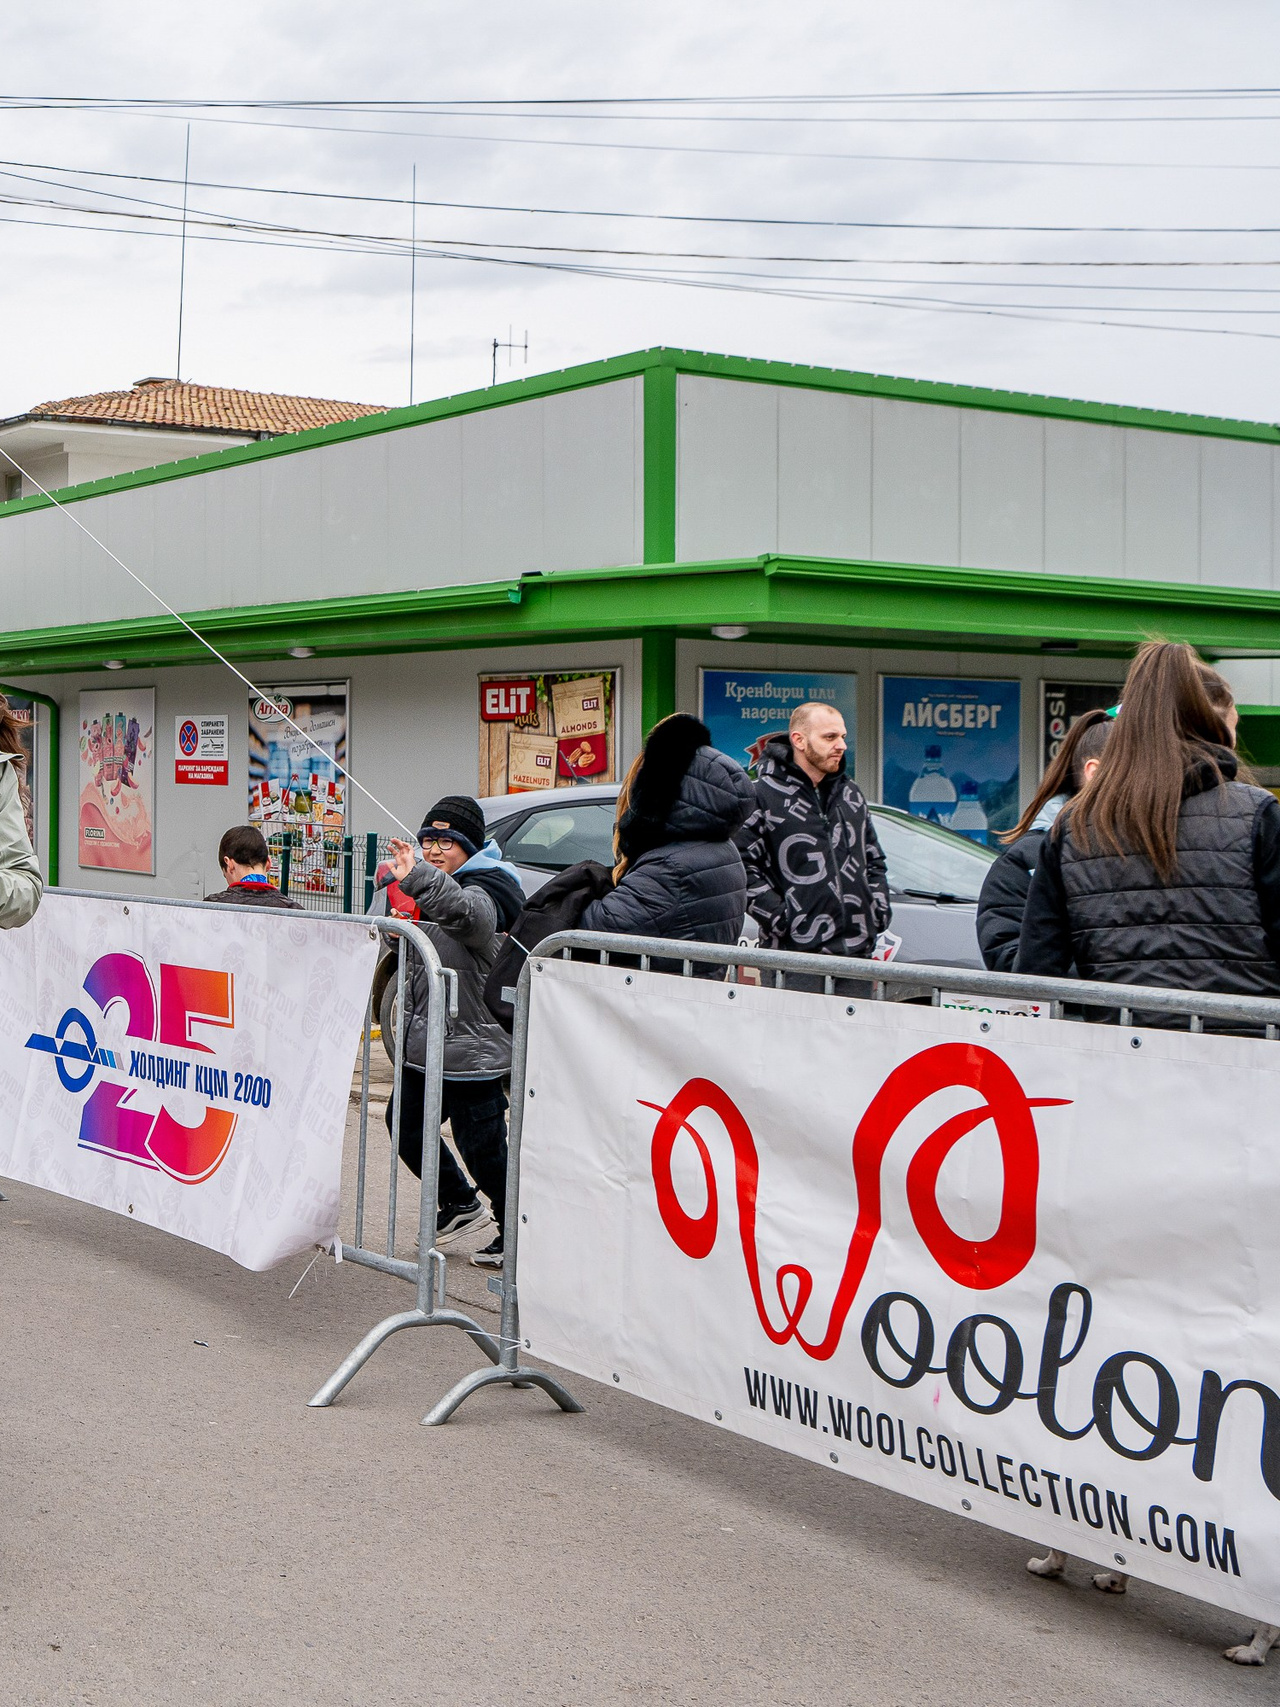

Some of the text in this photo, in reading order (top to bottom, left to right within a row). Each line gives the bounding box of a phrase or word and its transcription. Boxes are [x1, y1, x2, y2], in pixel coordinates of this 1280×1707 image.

[724, 681, 836, 702] Кренвирш или
[514, 709, 539, 727] nuts
[741, 707, 793, 724] надени
[901, 697, 1002, 729] АЙСБЕРГ
[561, 721, 598, 734] ALMONDS
[513, 774, 550, 786] HAZELNUTS
[129, 1050, 271, 1108] ХОЛДИНГ КЦМ 2000
[744, 1367, 1241, 1577] WWW.WOOLCOLLECTION.COM
